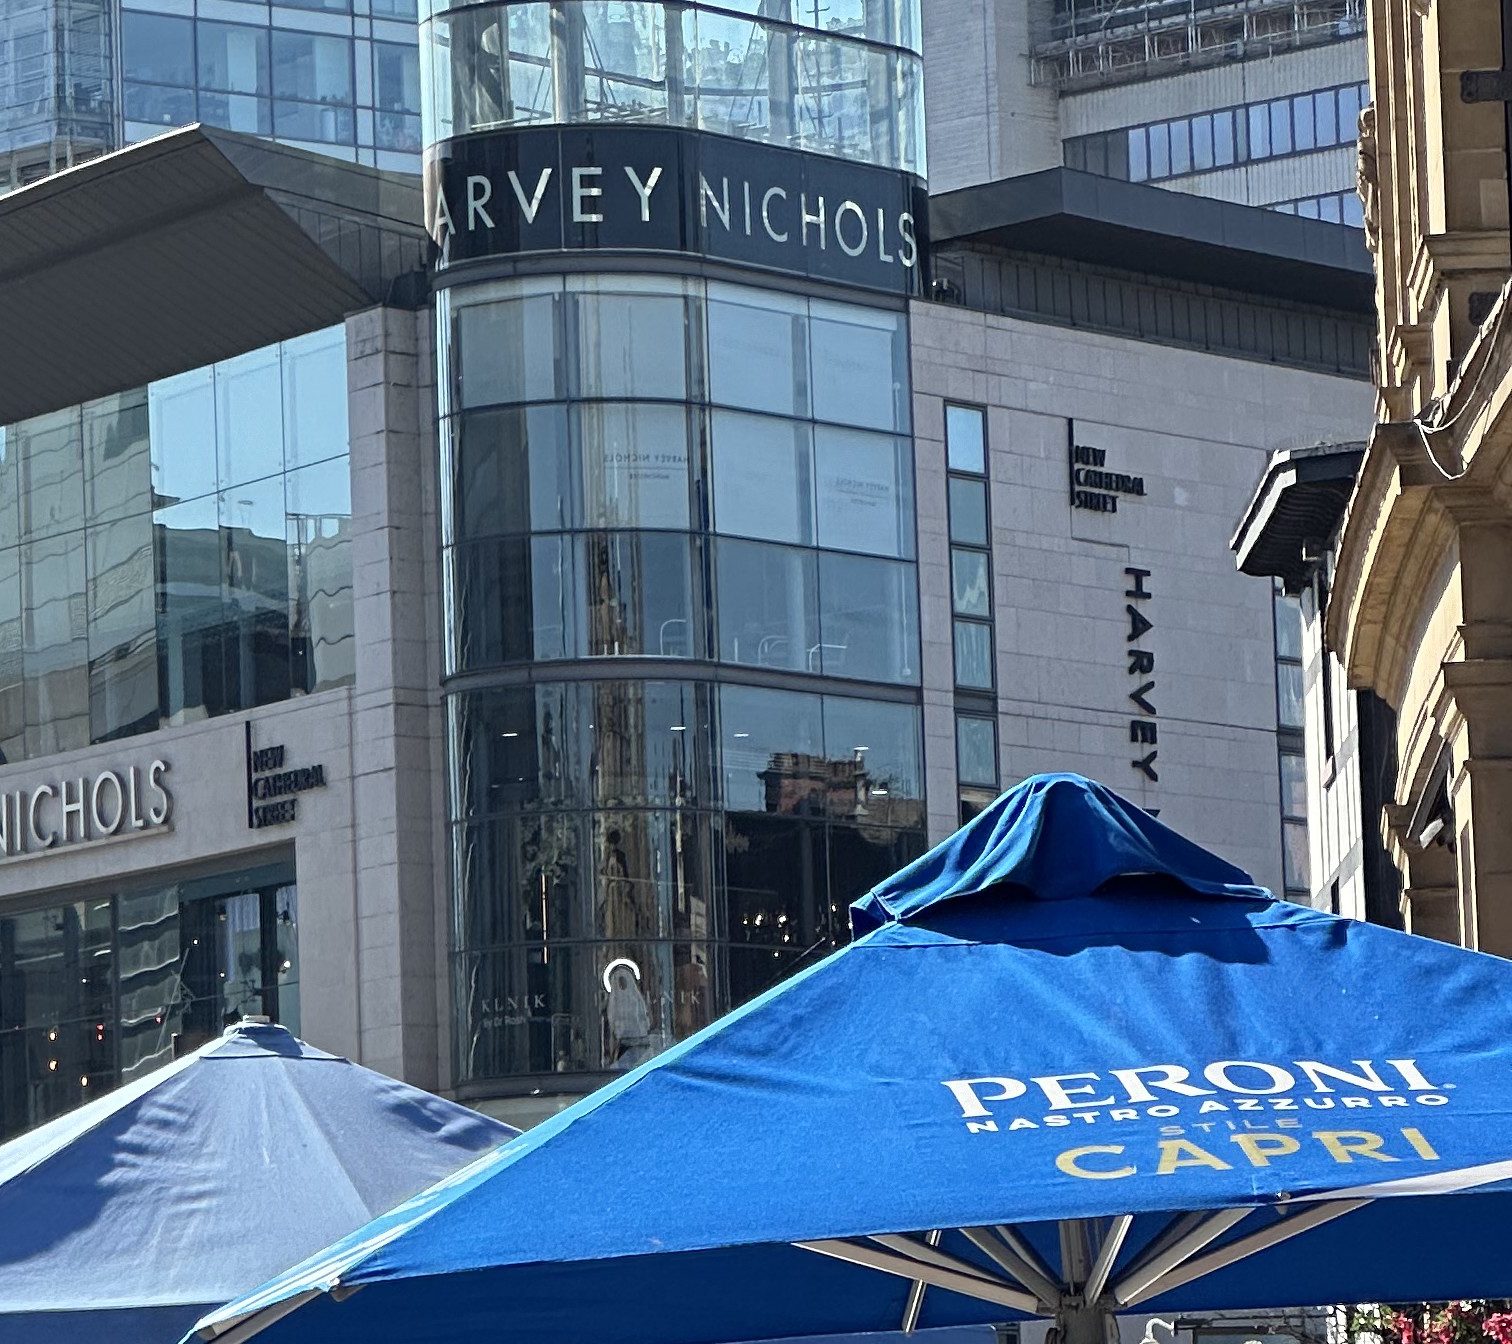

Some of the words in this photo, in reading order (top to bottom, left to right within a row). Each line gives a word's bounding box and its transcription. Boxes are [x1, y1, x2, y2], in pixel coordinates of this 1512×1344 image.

[432, 166, 663, 242] ARVEY
[699, 170, 918, 268] NICHOLS
[1124, 567, 1160, 783] HARVEY
[940, 1058, 1446, 1118] PERONI
[966, 1104, 1180, 1134] NASTRO
[1199, 1094, 1450, 1115] AZZURRO
[1055, 1127, 1441, 1180] CAPRI
[1159, 1117, 1303, 1137] STILE
